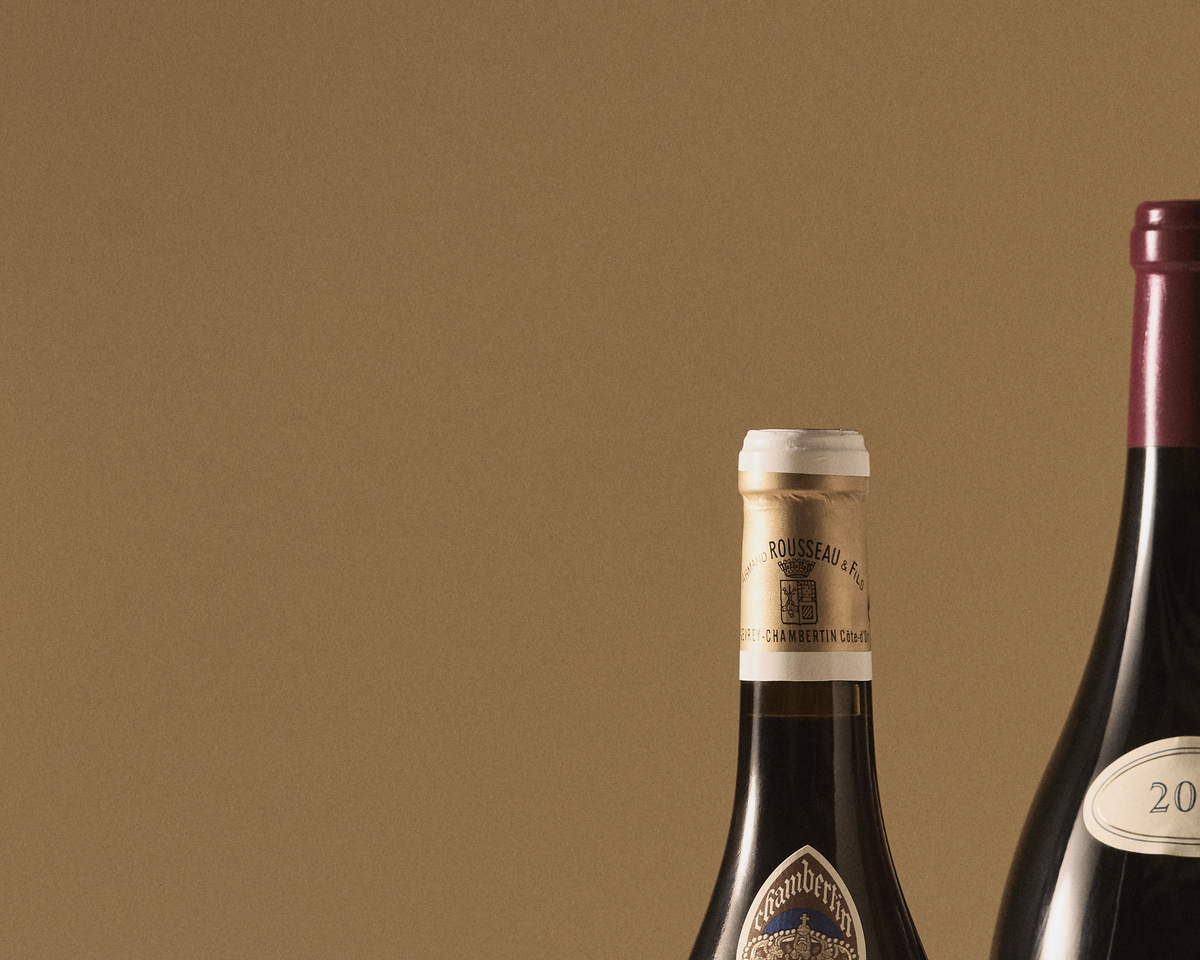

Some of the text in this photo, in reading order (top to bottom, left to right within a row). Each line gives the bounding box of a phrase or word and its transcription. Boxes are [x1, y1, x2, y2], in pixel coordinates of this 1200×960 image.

[769, 538, 840, 566] ROUSSEAU
[841, 560, 848, 572] &
[741, 629, 837, 643] EVREY-CHAMBERTIN
